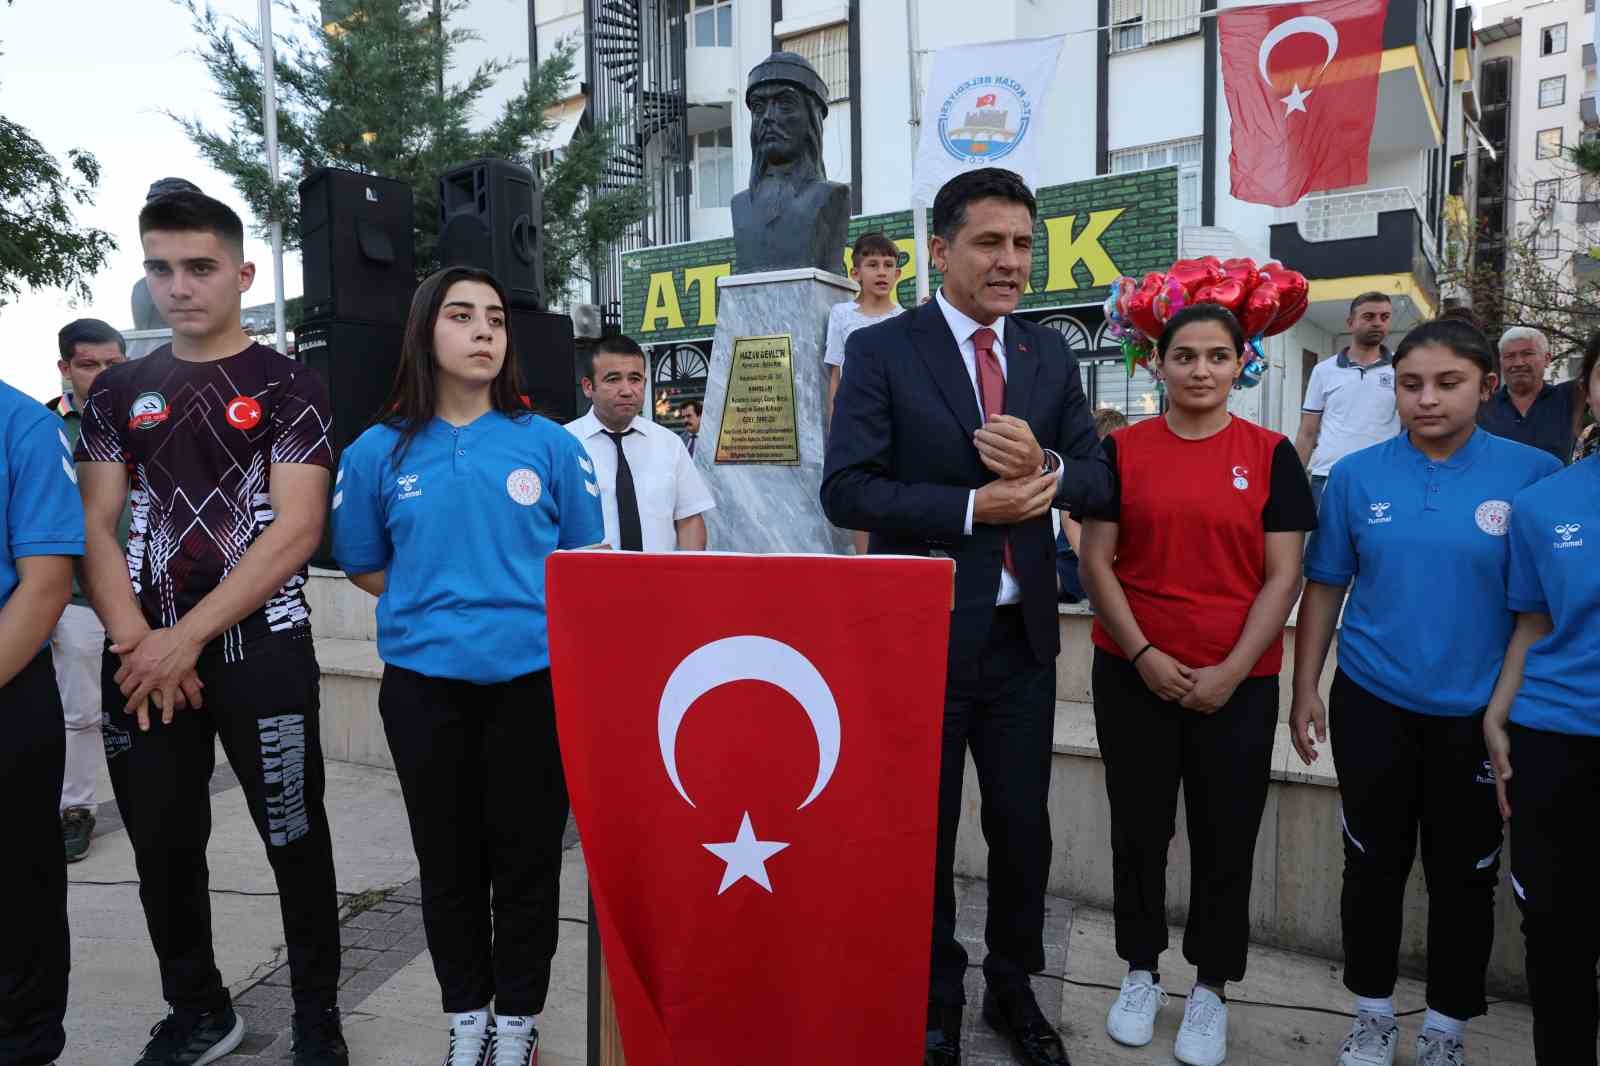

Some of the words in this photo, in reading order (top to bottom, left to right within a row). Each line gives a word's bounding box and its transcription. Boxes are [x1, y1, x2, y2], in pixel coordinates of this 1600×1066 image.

[398, 490, 423, 500] hummel
[1552, 538, 1584, 550] hummel
[257, 718, 283, 784] KOZAN
[278, 714, 309, 842] ARMWRESTLING
[264, 795, 289, 847] TEAM
